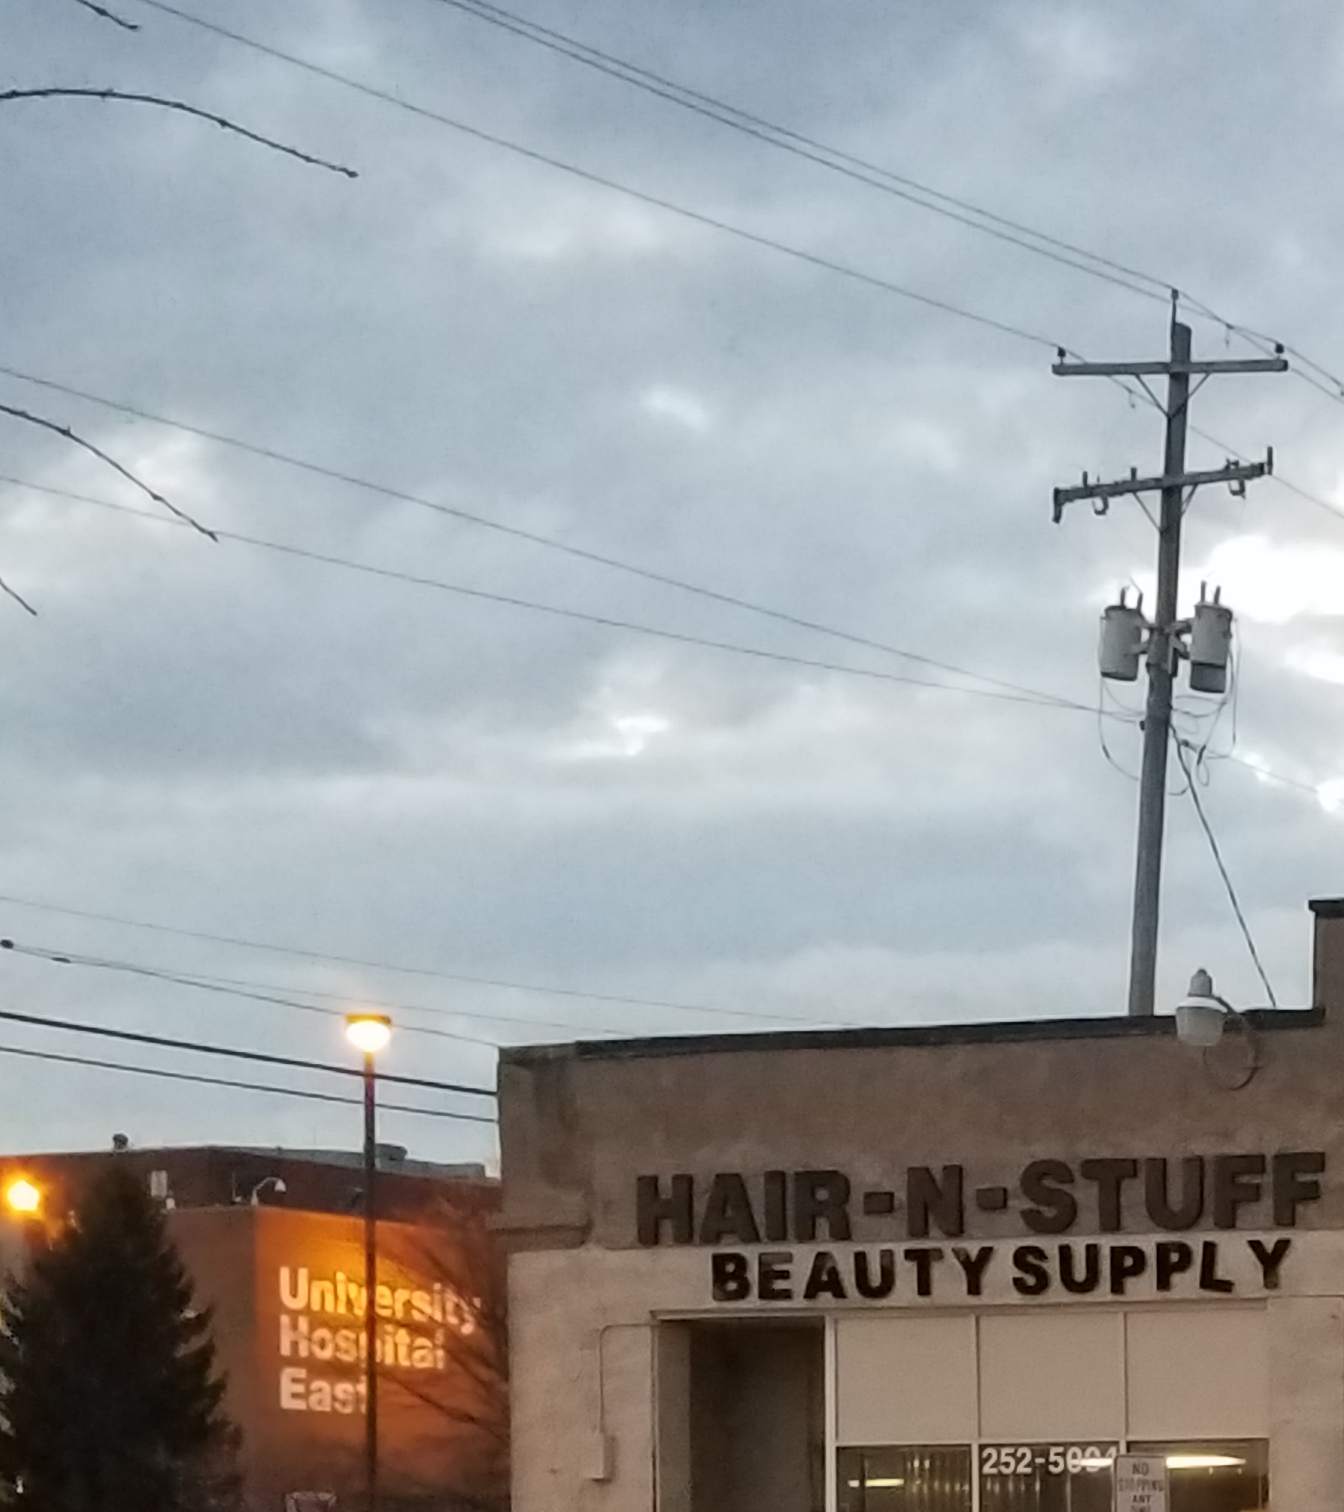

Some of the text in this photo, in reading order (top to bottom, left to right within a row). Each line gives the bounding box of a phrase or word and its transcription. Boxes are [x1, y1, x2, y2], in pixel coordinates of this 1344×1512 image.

[636, 1152, 1326, 1246] HAIR-N-STUFF
[711, 1239, 1292, 1302] BEAUTY SUPPLY
